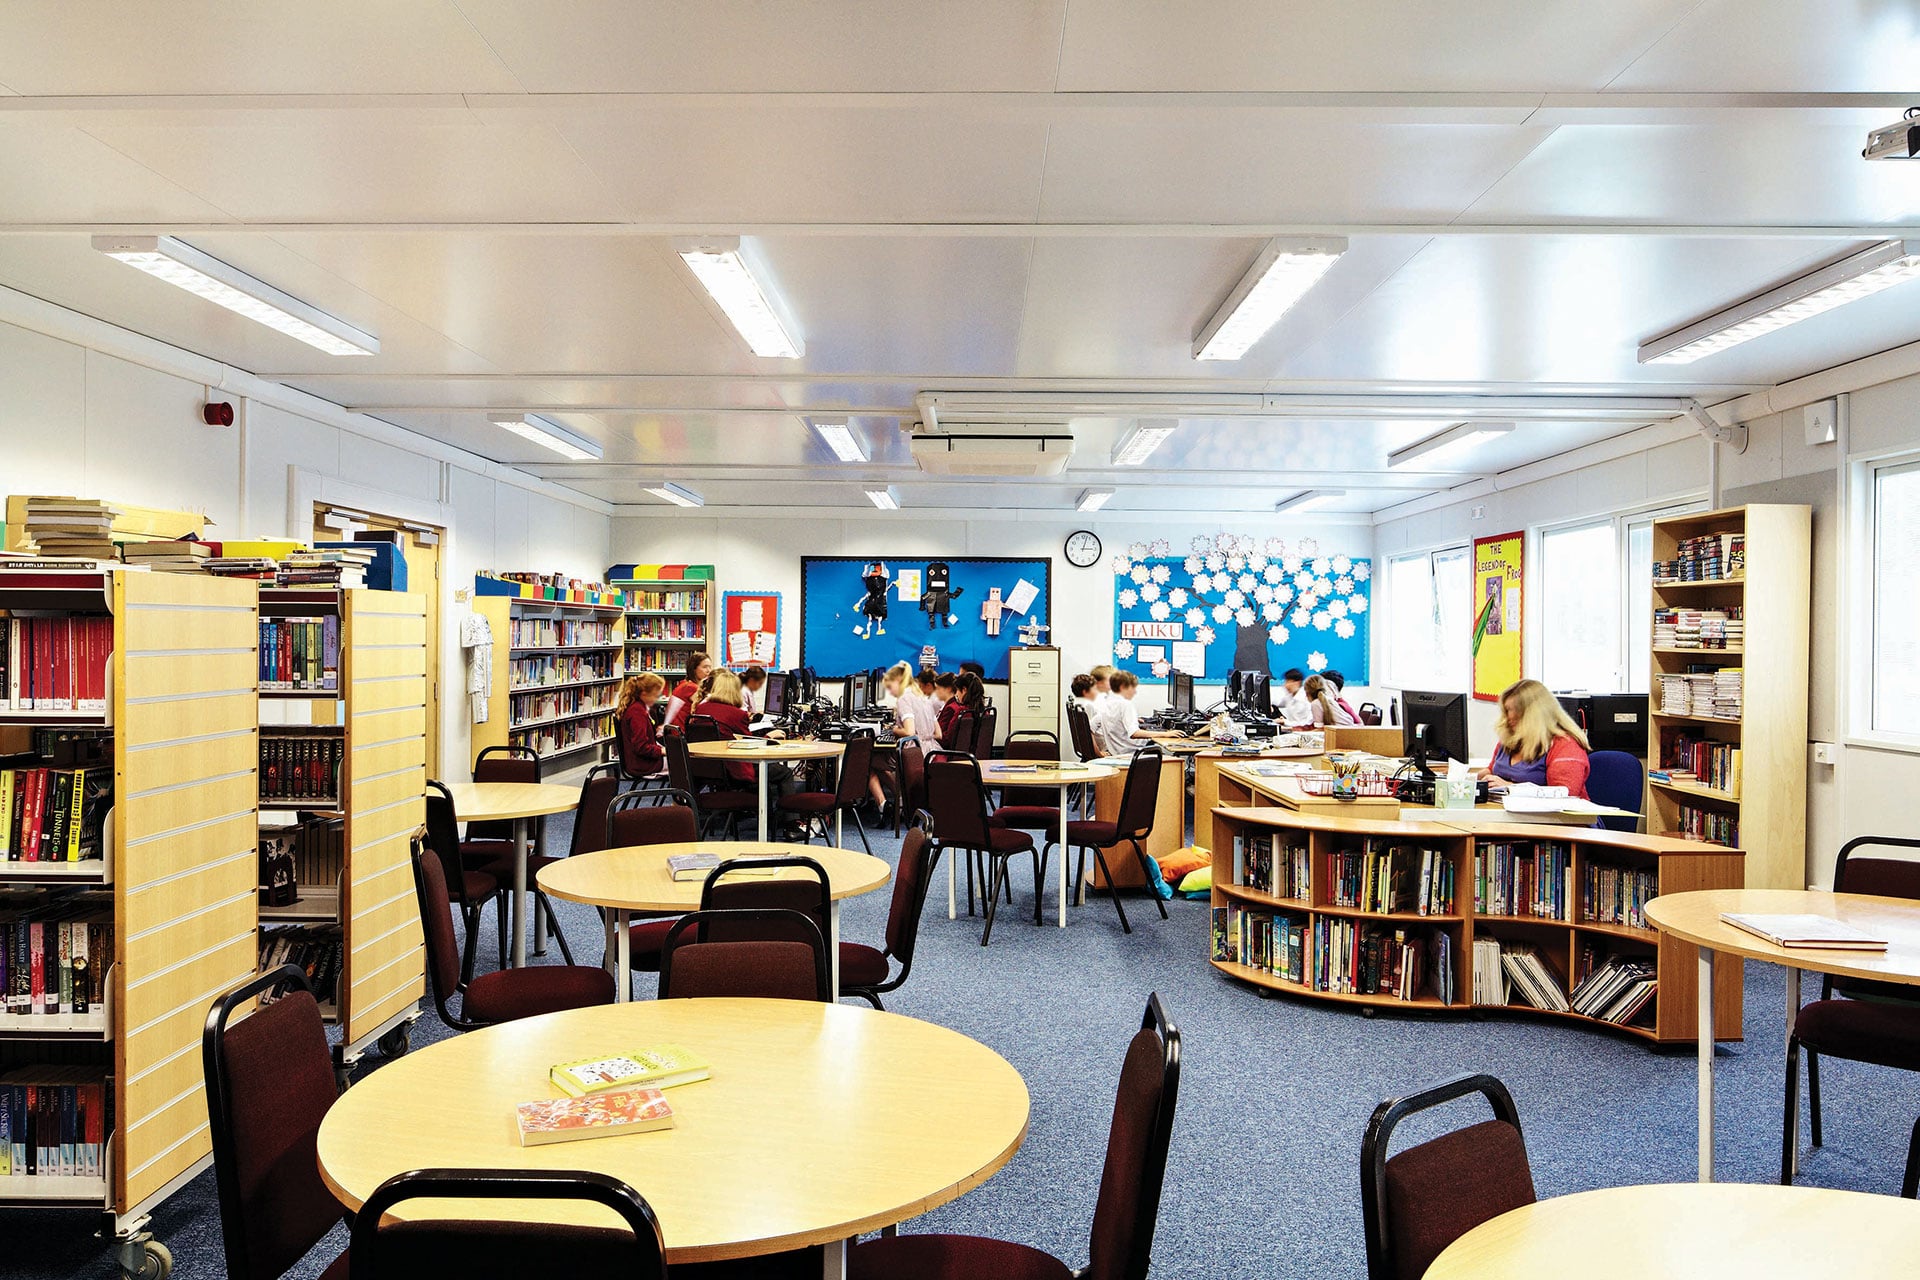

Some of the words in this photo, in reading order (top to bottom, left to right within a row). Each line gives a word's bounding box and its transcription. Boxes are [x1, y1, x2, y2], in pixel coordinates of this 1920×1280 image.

[1490, 544, 1501, 555] THE
[1124, 623, 1181, 638] HAIKU
[52, 808, 66, 845] TUNNELS
